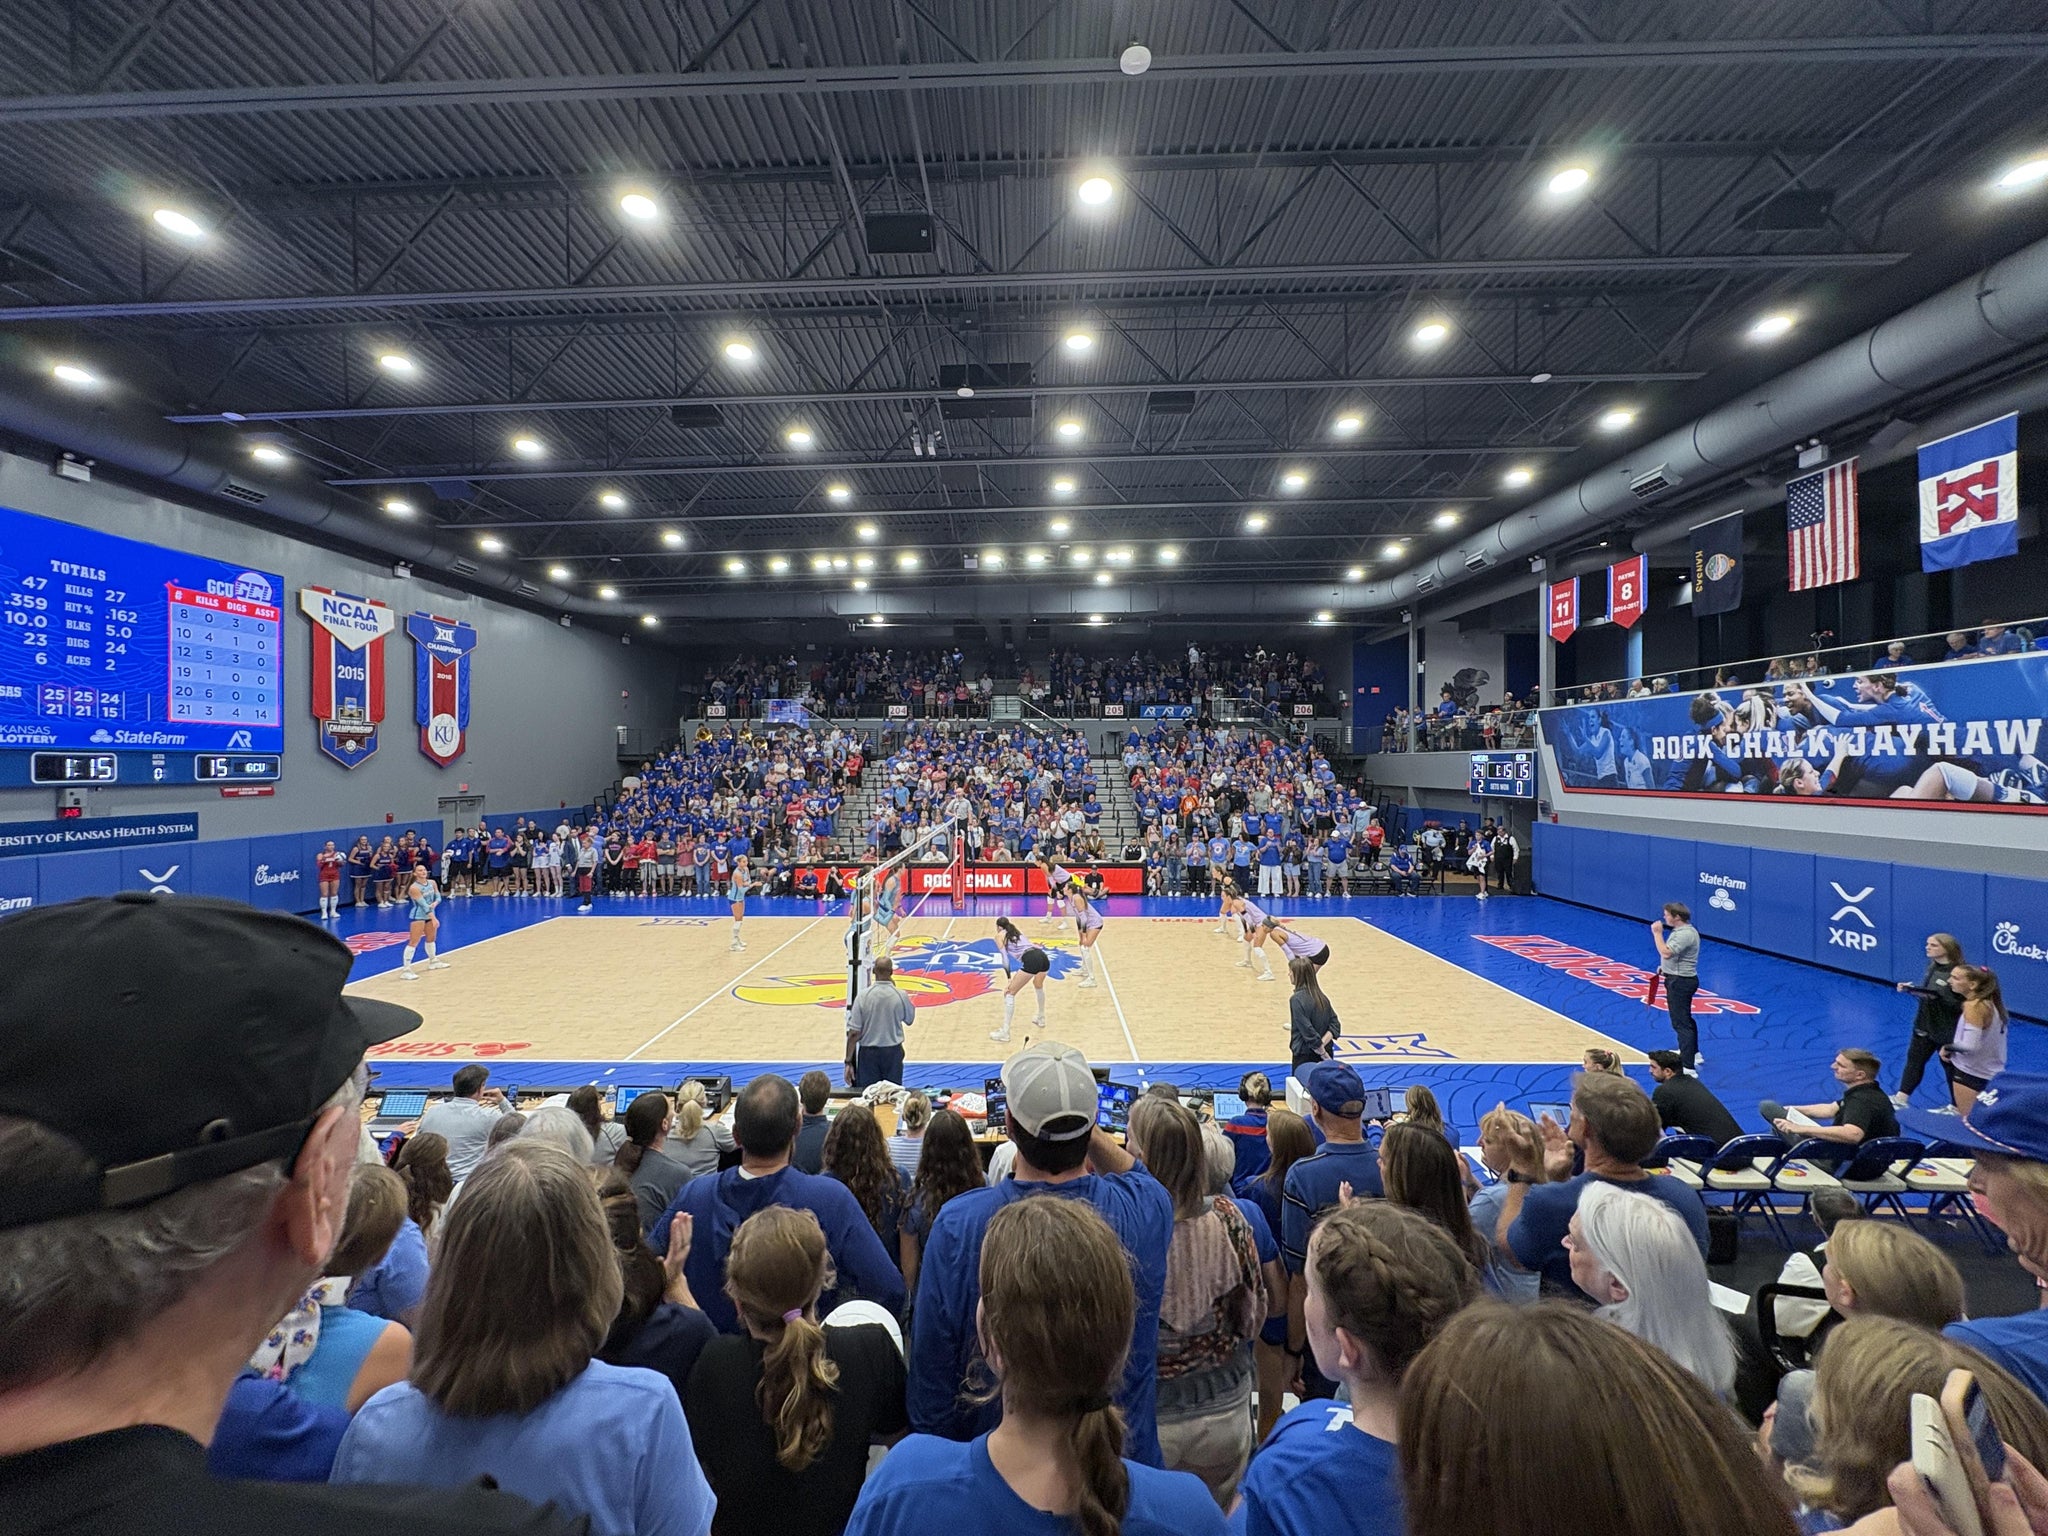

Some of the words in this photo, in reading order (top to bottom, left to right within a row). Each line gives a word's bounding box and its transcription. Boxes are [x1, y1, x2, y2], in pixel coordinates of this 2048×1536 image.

[50, 560, 106, 582] TOTALS
[1618, 570, 1636, 581] PAYNE
[1696, 550, 1704, 593] KANSAS
[22, 576, 48, 590] 47
[65, 584, 94, 598] KILLS
[105, 590, 126, 603] 27
[207, 578, 234, 598] GCU
[1621, 582, 1633, 600] 8
[4, 592, 48, 610] .359
[65, 602, 82, 613] HIT
[84, 604, 94, 615] %
[105, 608, 138, 624] .162
[196, 595, 220, 607] KILLS
[226, 602, 247, 612] DIGS
[254, 607, 276, 618] ASST
[322, 598, 378, 623] NCAA
[1556, 601, 1569, 618] 11
[4, 610, 48, 628] 10.0
[66, 620, 92, 632] BLKS
[106, 624, 132, 638] 5.0
[180, 608, 188, 619] 8
[204, 613, 214, 623] 0
[232, 618, 240, 628] 3
[257, 623, 265, 632] 0
[323, 614, 352, 628] FINAL
[354, 622, 378, 633] FOUR
[24, 632, 48, 646] 23
[66, 637, 90, 649] DIGS
[105, 642, 127, 654] 24
[176, 628, 191, 639] 10
[205, 632, 213, 642] 4
[234, 636, 238, 646] 1
[257, 640, 265, 650] 0
[177, 646, 191, 657] 12
[205, 650, 213, 660] 5
[232, 654, 240, 663] 3
[257, 657, 265, 667] 0
[427, 642, 462, 655] CHAMPIONS
[36, 652, 48, 665] 6
[66, 654, 92, 666] ACES
[105, 659, 116, 670] 2
[177, 666, 191, 677] 19
[206, 670, 211, 680] 1
[232, 673, 240, 682] 0
[257, 676, 265, 685] 0
[337, 665, 365, 681] 2015
[44, 688, 65, 700] 25
[74, 691, 94, 702] 25
[100, 693, 120, 704] 24
[175, 686, 192, 696] 20
[205, 688, 213, 698] 6
[232, 691, 240, 701] 0
[257, 693, 265, 703] 0
[46, 704, 63, 715] 21
[75, 706, 92, 716] 21
[102, 707, 118, 718] 15
[178, 704, 191, 715] 21
[205, 706, 213, 716] 3
[232, 708, 240, 718] 4
[255, 710, 267, 720] 14
[709, 706, 726, 715] 203
[889, 706, 907, 715] 204
[1106, 706, 1123, 715] 205
[1295, 706, 1312, 715] 206
[0, 724, 51, 735] KANSAS
[435, 726, 454, 745] KU
[0, 734, 58, 744] LOTTERY
[1652, 734, 1714, 760] ROCK
[1726, 729, 1830, 759] CHALK
[1848, 718, 2042, 756] JAYHAW
[210, 758, 228, 777] 15
[245, 762, 266, 772] GCU
[1474, 764, 1484, 777] 24
[1520, 764, 1529, 778] 15
[1478, 780, 1484, 793] 2
[1516, 781, 1523, 795] 0
[0, 834, 44, 847] ERSITY
[45, 833, 63, 843] OF
[65, 829, 111, 842] KANSAS
[113, 826, 156, 838] HEALTH
[158, 824, 194, 834] SYSTEM
[924, 874, 952, 888] ROC
[966, 874, 1012, 888] CHALK
[1828, 926, 1878, 952] XRP
[1992, 921, 2048, 960] Chick-
[925, 951, 1002, 964] KU
